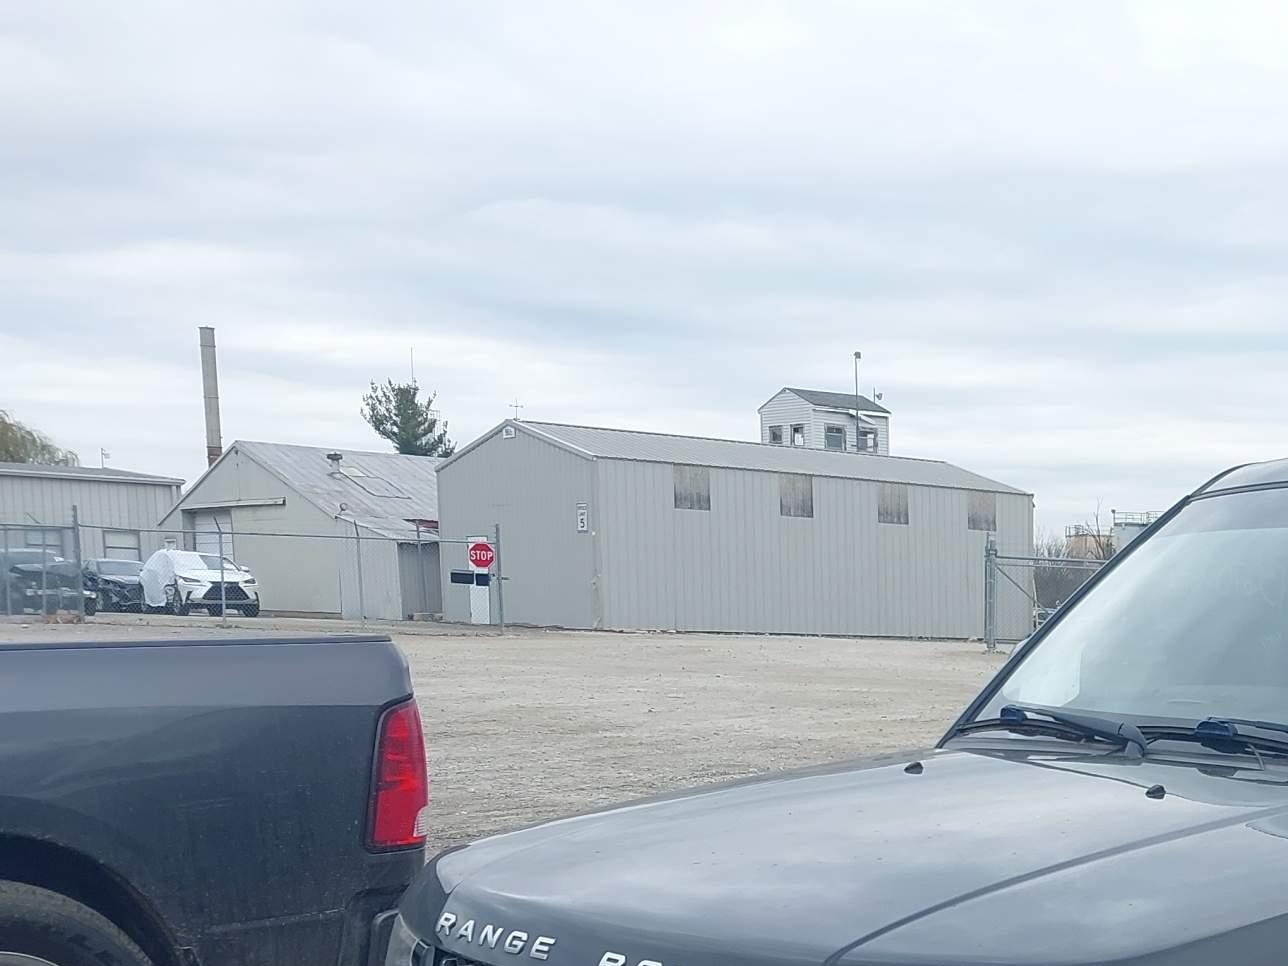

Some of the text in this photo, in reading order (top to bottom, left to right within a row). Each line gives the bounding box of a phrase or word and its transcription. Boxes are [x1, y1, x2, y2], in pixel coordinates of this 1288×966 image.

[579, 518, 585, 529] 5
[470, 550, 493, 561] STOP
[435, 912, 556, 960] RANGE
